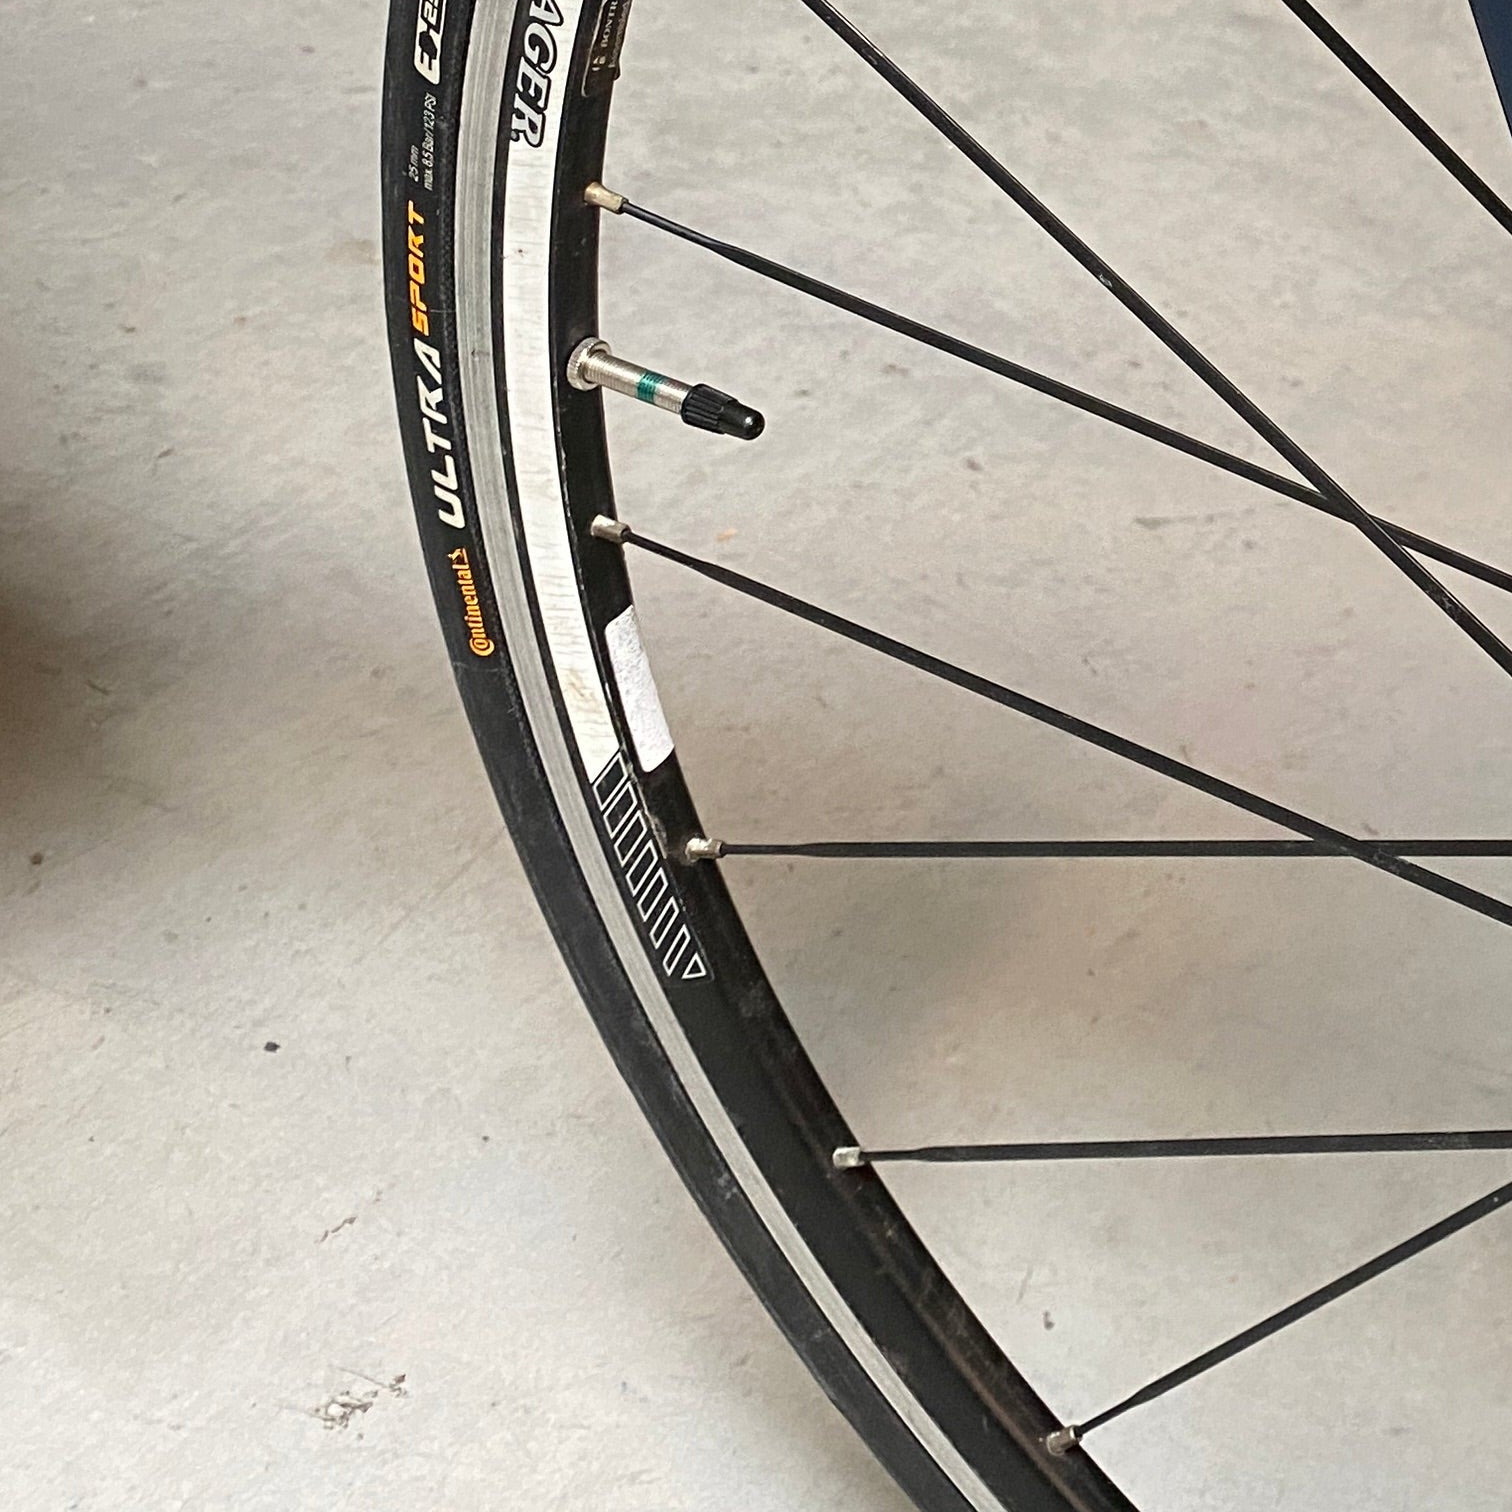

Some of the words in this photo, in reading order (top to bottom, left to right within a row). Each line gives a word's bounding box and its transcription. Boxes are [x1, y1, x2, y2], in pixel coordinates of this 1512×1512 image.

[406, 199, 430, 336] SPORT
[412, 337, 466, 530] ULTRA
[454, 560, 494, 657] Continental
